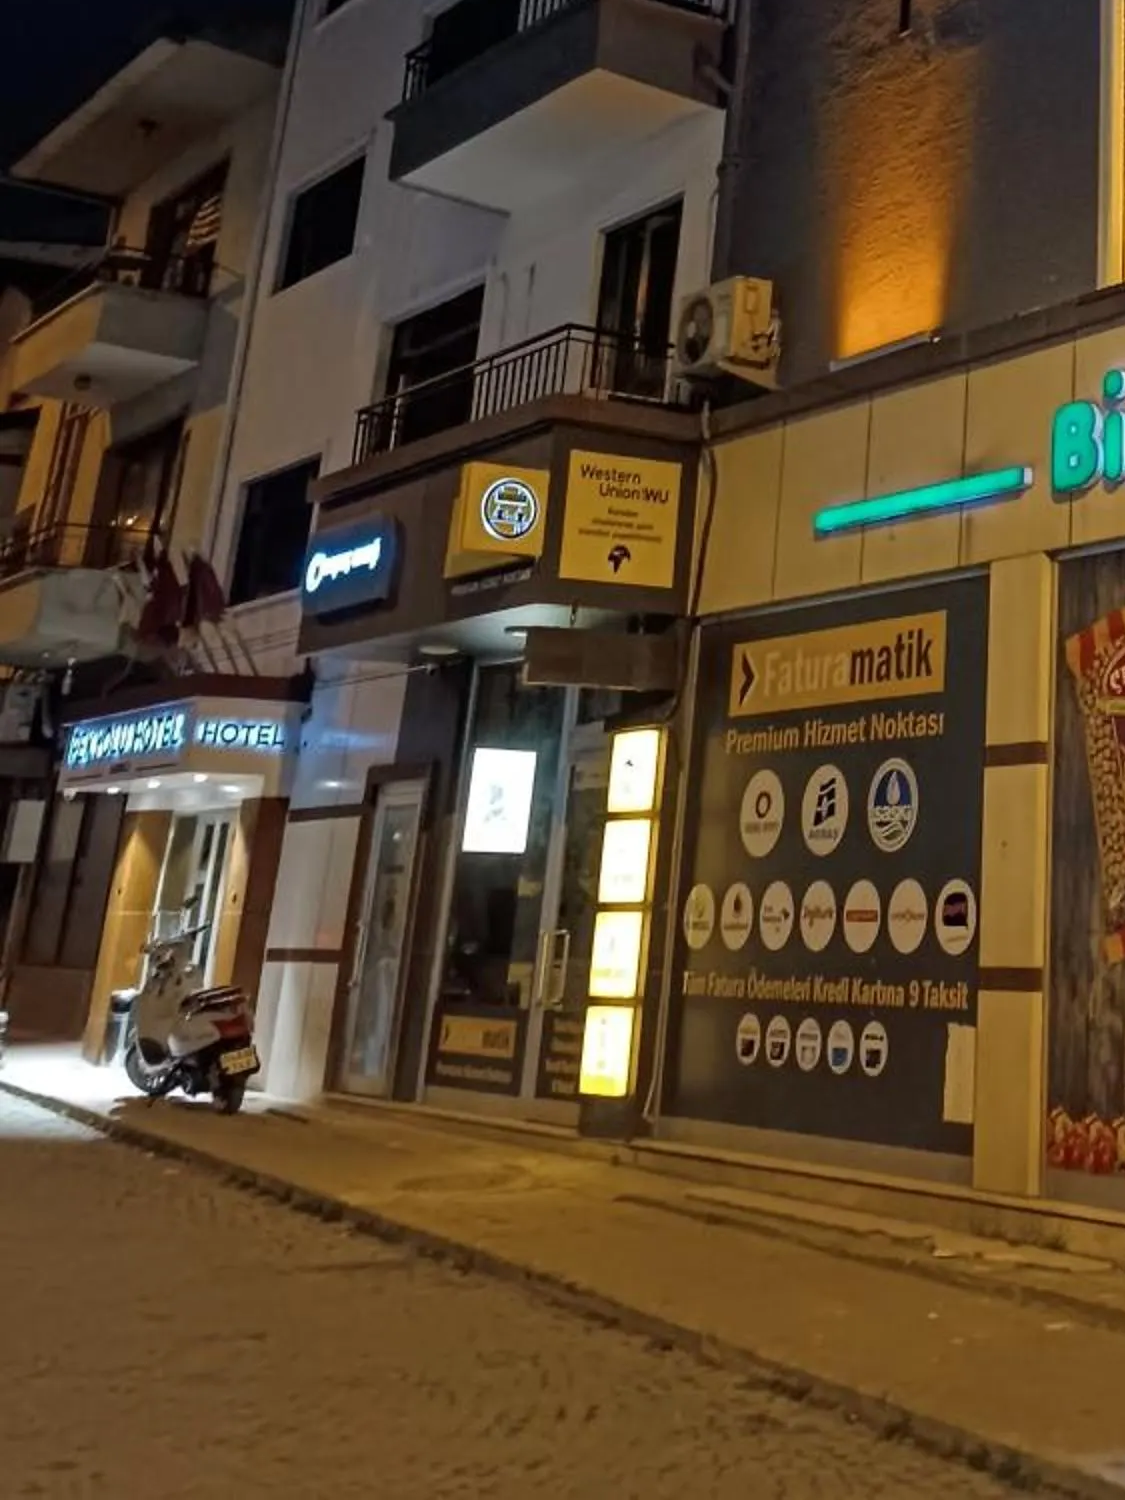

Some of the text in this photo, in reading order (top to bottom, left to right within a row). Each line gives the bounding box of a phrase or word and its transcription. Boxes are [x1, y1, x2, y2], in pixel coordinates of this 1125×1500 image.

[580, 463, 641, 485] Western
[599, 482, 640, 501] Union
[763, 627, 933, 697] Faturamatik
[199, 721, 285, 747] HOTEL
[726, 711, 945, 754] Premium Hizmet Noktası
[909, 979, 920, 1008] 9
[921, 979, 969, 1011] Taksit
